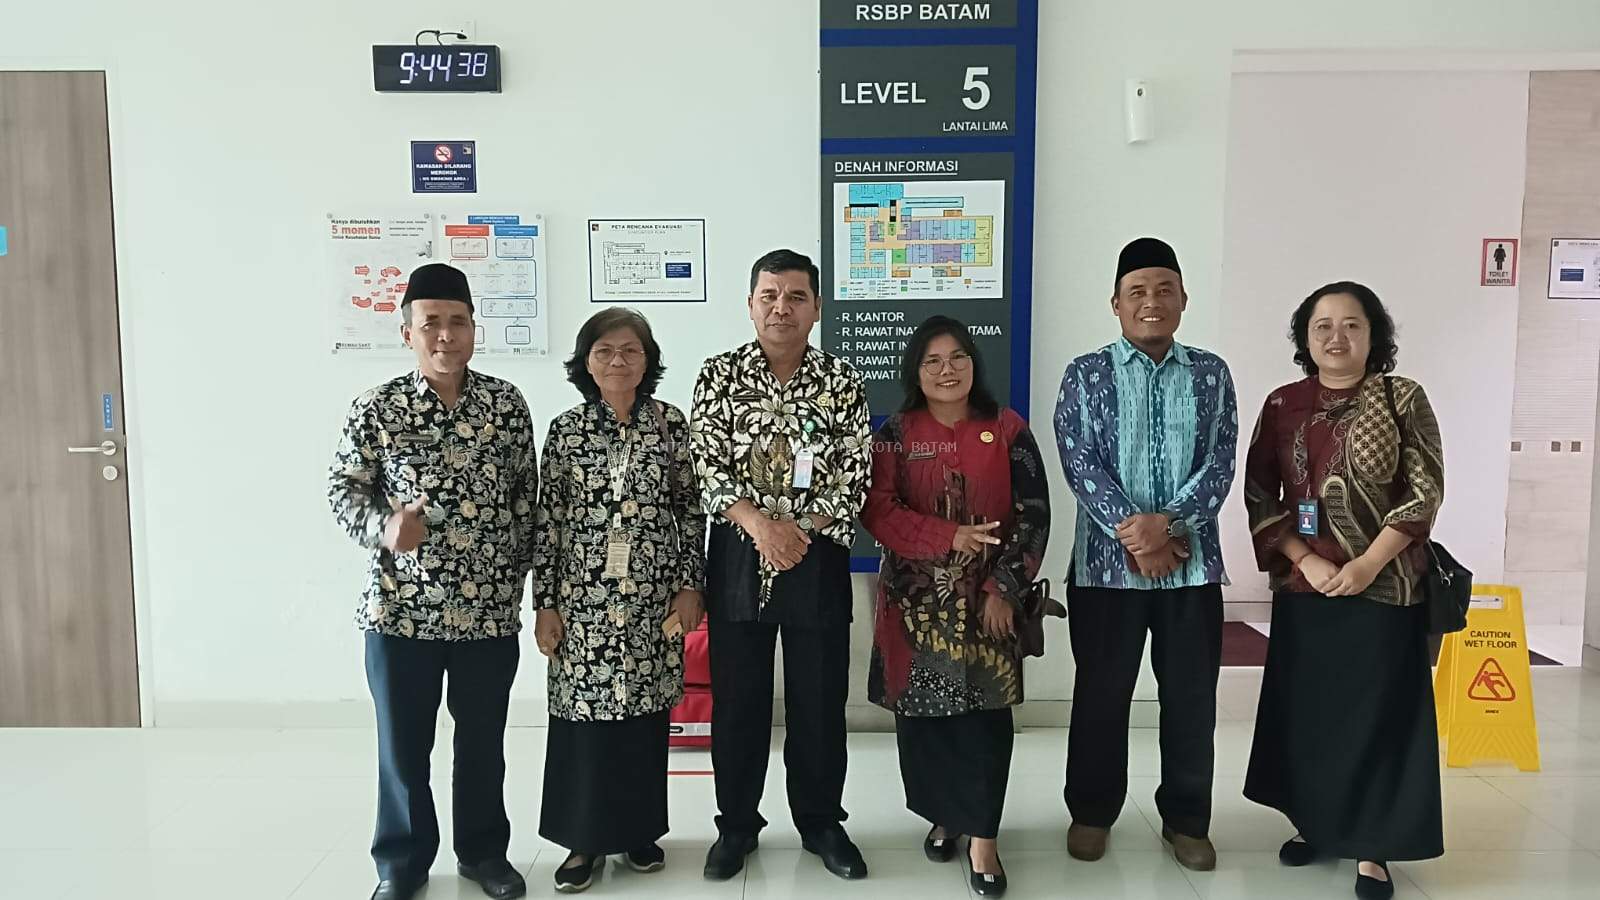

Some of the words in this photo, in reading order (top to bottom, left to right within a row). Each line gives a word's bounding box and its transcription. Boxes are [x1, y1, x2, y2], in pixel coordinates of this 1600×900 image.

[856, 4, 912, 21] RSBP
[919, 3, 991, 20] BATAM
[399, 52, 452, 84] 9:44
[457, 52, 488, 77] 38
[840, 81, 926, 104] LEVEL
[961, 66, 991, 111] 5
[943, 122, 980, 132] LANTAI
[983, 121, 1009, 131] LIMA
[834, 161, 881, 173] DENAH
[885, 160, 959, 173] INFORMASI
[331, 225, 338, 234] 5
[341, 226, 381, 235] momen
[856, 311, 905, 322] KANTOR
[854, 326, 894, 337] RAWAT
[856, 341, 896, 351] RAWAT
[856, 355, 896, 366] RAWAT
[1470, 630, 1511, 639] CAUTION
[1464, 639, 1484, 648] WET
[1487, 640, 1518, 649] FLOOR
